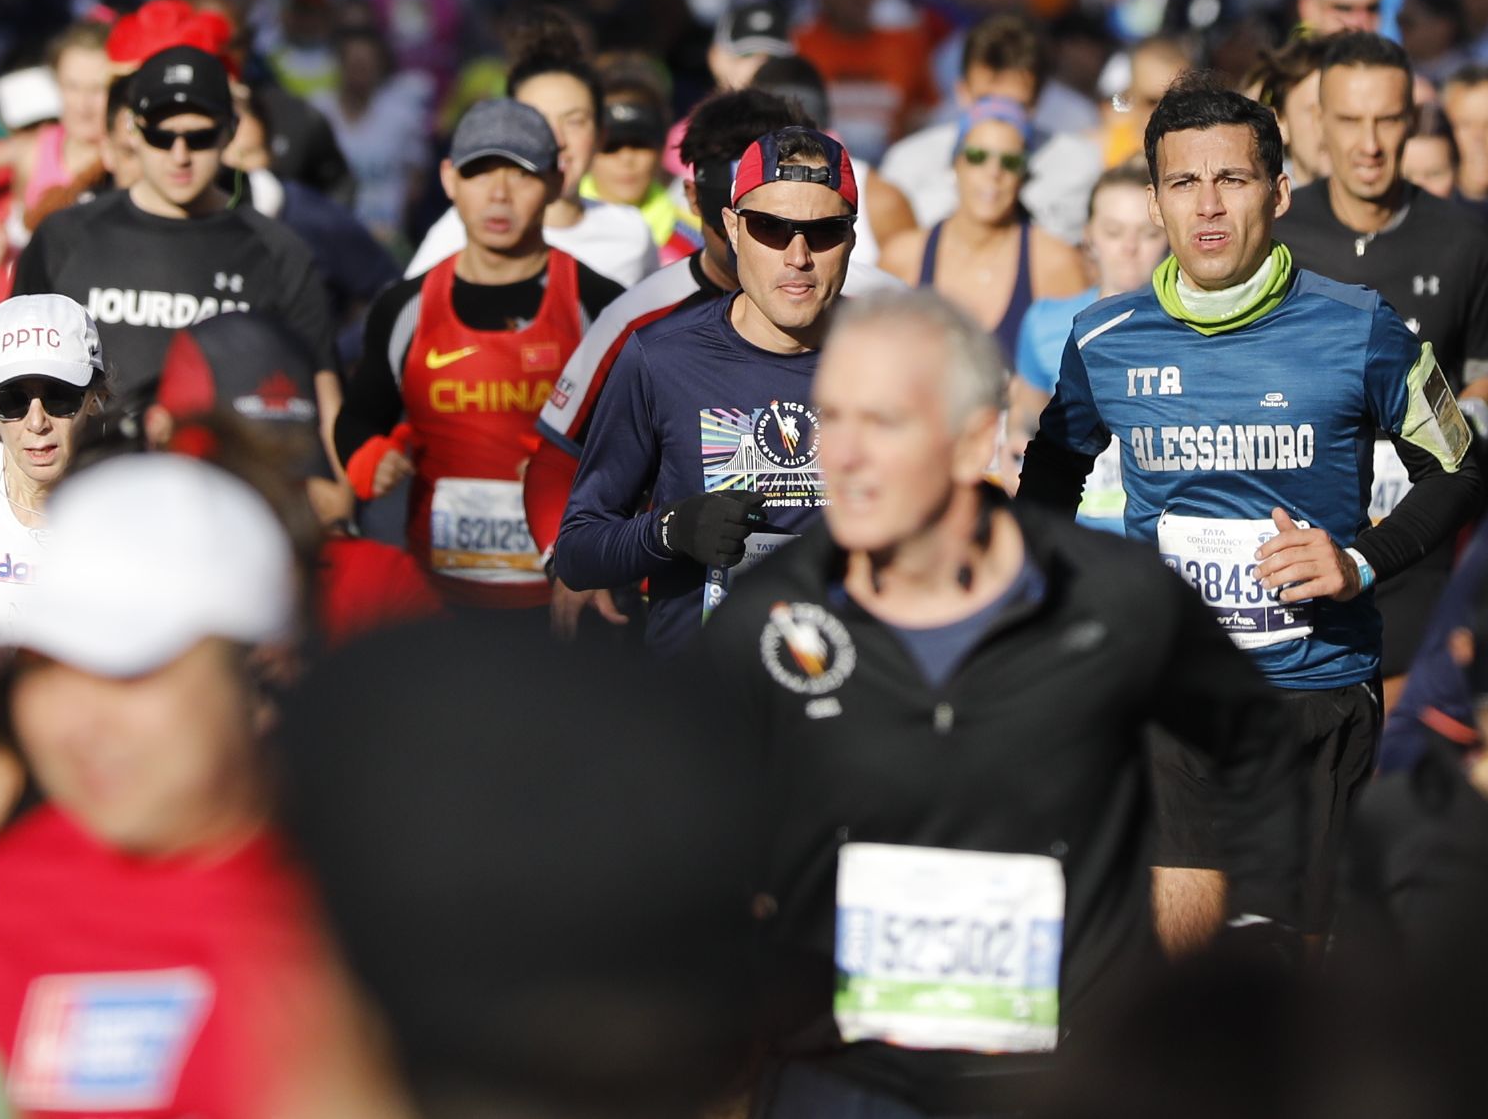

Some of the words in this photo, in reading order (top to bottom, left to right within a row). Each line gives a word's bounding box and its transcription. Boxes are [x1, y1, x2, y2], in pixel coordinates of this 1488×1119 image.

[1, 327, 61, 353] PPTC
[1127, 366, 1183, 397] ITA
[429, 379, 554, 413] CHINA
[782, 402, 805, 414] TCS
[804, 410, 821, 431] NEW
[757, 412, 782, 463] MARATHON
[806, 433, 821, 458] YORK
[1131, 424, 1314, 472] ALESSANDRO
[783, 455, 806, 466] CITY
[762, 498, 803, 508] VEMBER
[804, 498, 813, 508] 3,
[1186, 535, 1243, 547] CONSULTANCY
[709, 569, 724, 606] 2019
[1185, 560, 1280, 605] 3843
